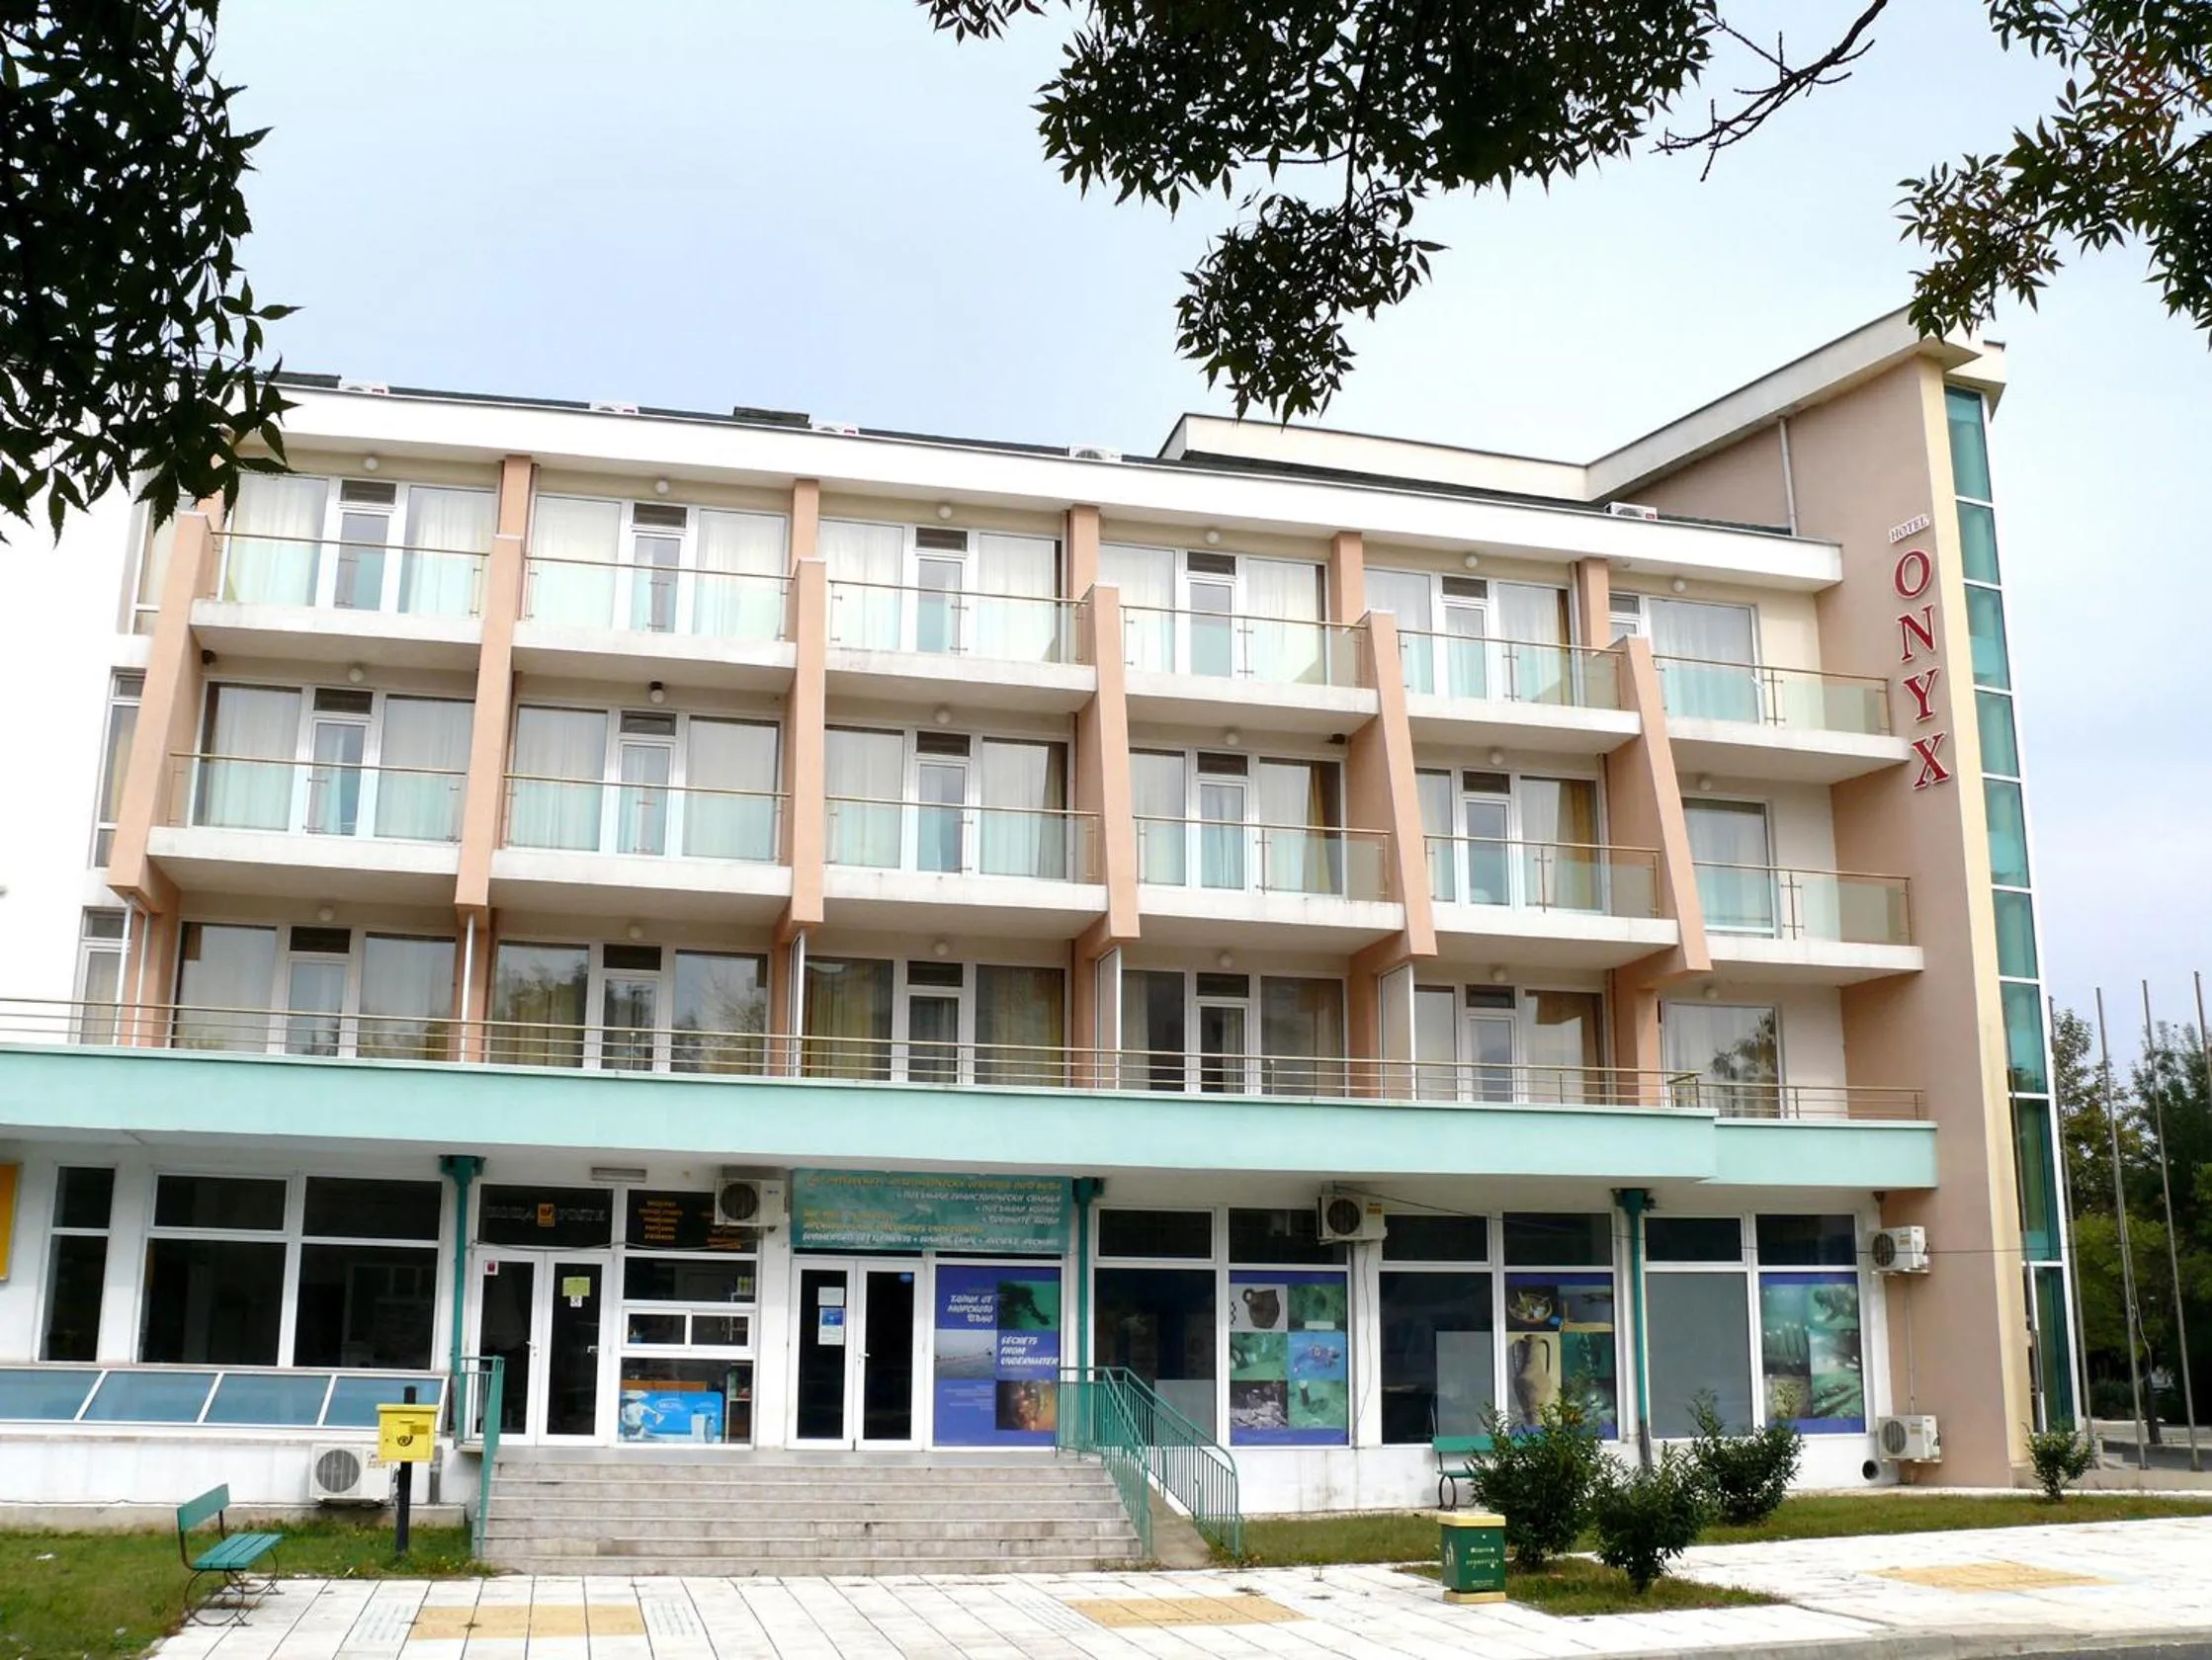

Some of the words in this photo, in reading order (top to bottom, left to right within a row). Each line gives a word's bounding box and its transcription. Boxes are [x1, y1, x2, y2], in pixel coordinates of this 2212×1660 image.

[1889, 514, 1930, 542] HOTEL
[1893, 548, 1951, 789] ONYX
[1000, 1336, 1038, 1346] SECRETS
[1000, 1346, 1026, 1356] FROM
